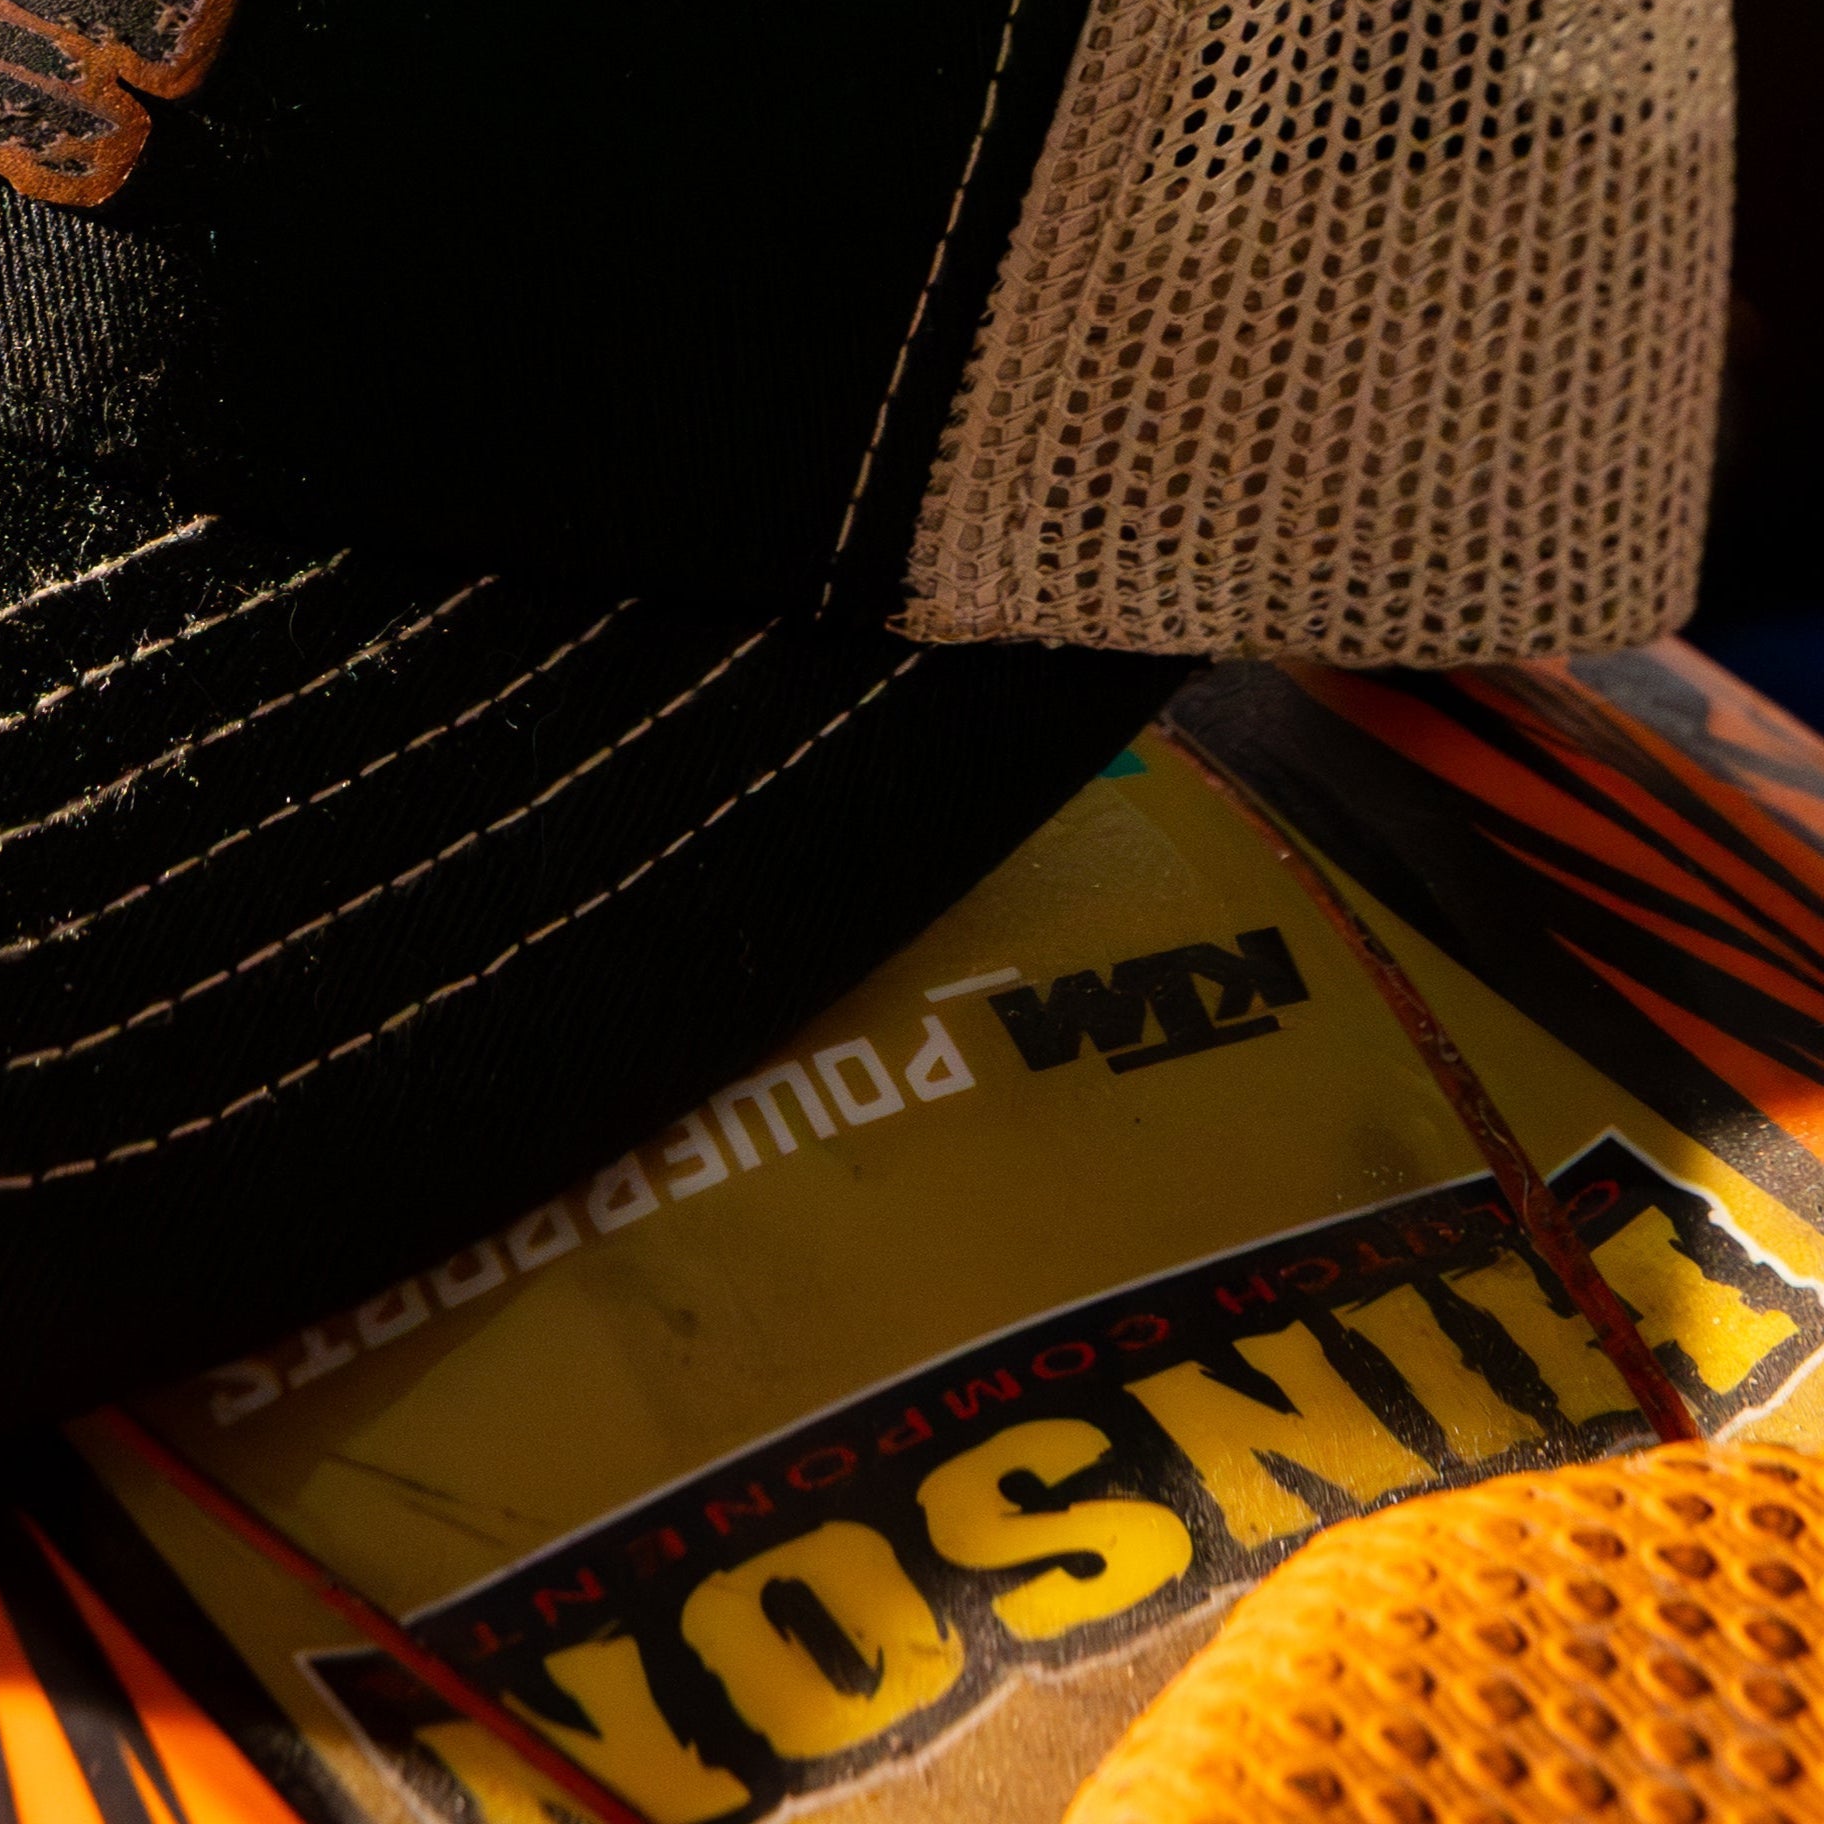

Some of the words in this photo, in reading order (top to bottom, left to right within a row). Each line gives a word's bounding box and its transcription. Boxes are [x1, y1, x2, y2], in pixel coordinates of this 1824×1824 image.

[988, 926, 1309, 1074] KTM
[366, 1312, 1175, 1686] COMPONENT
[416, 1204, 1796, 1824] HINSON
